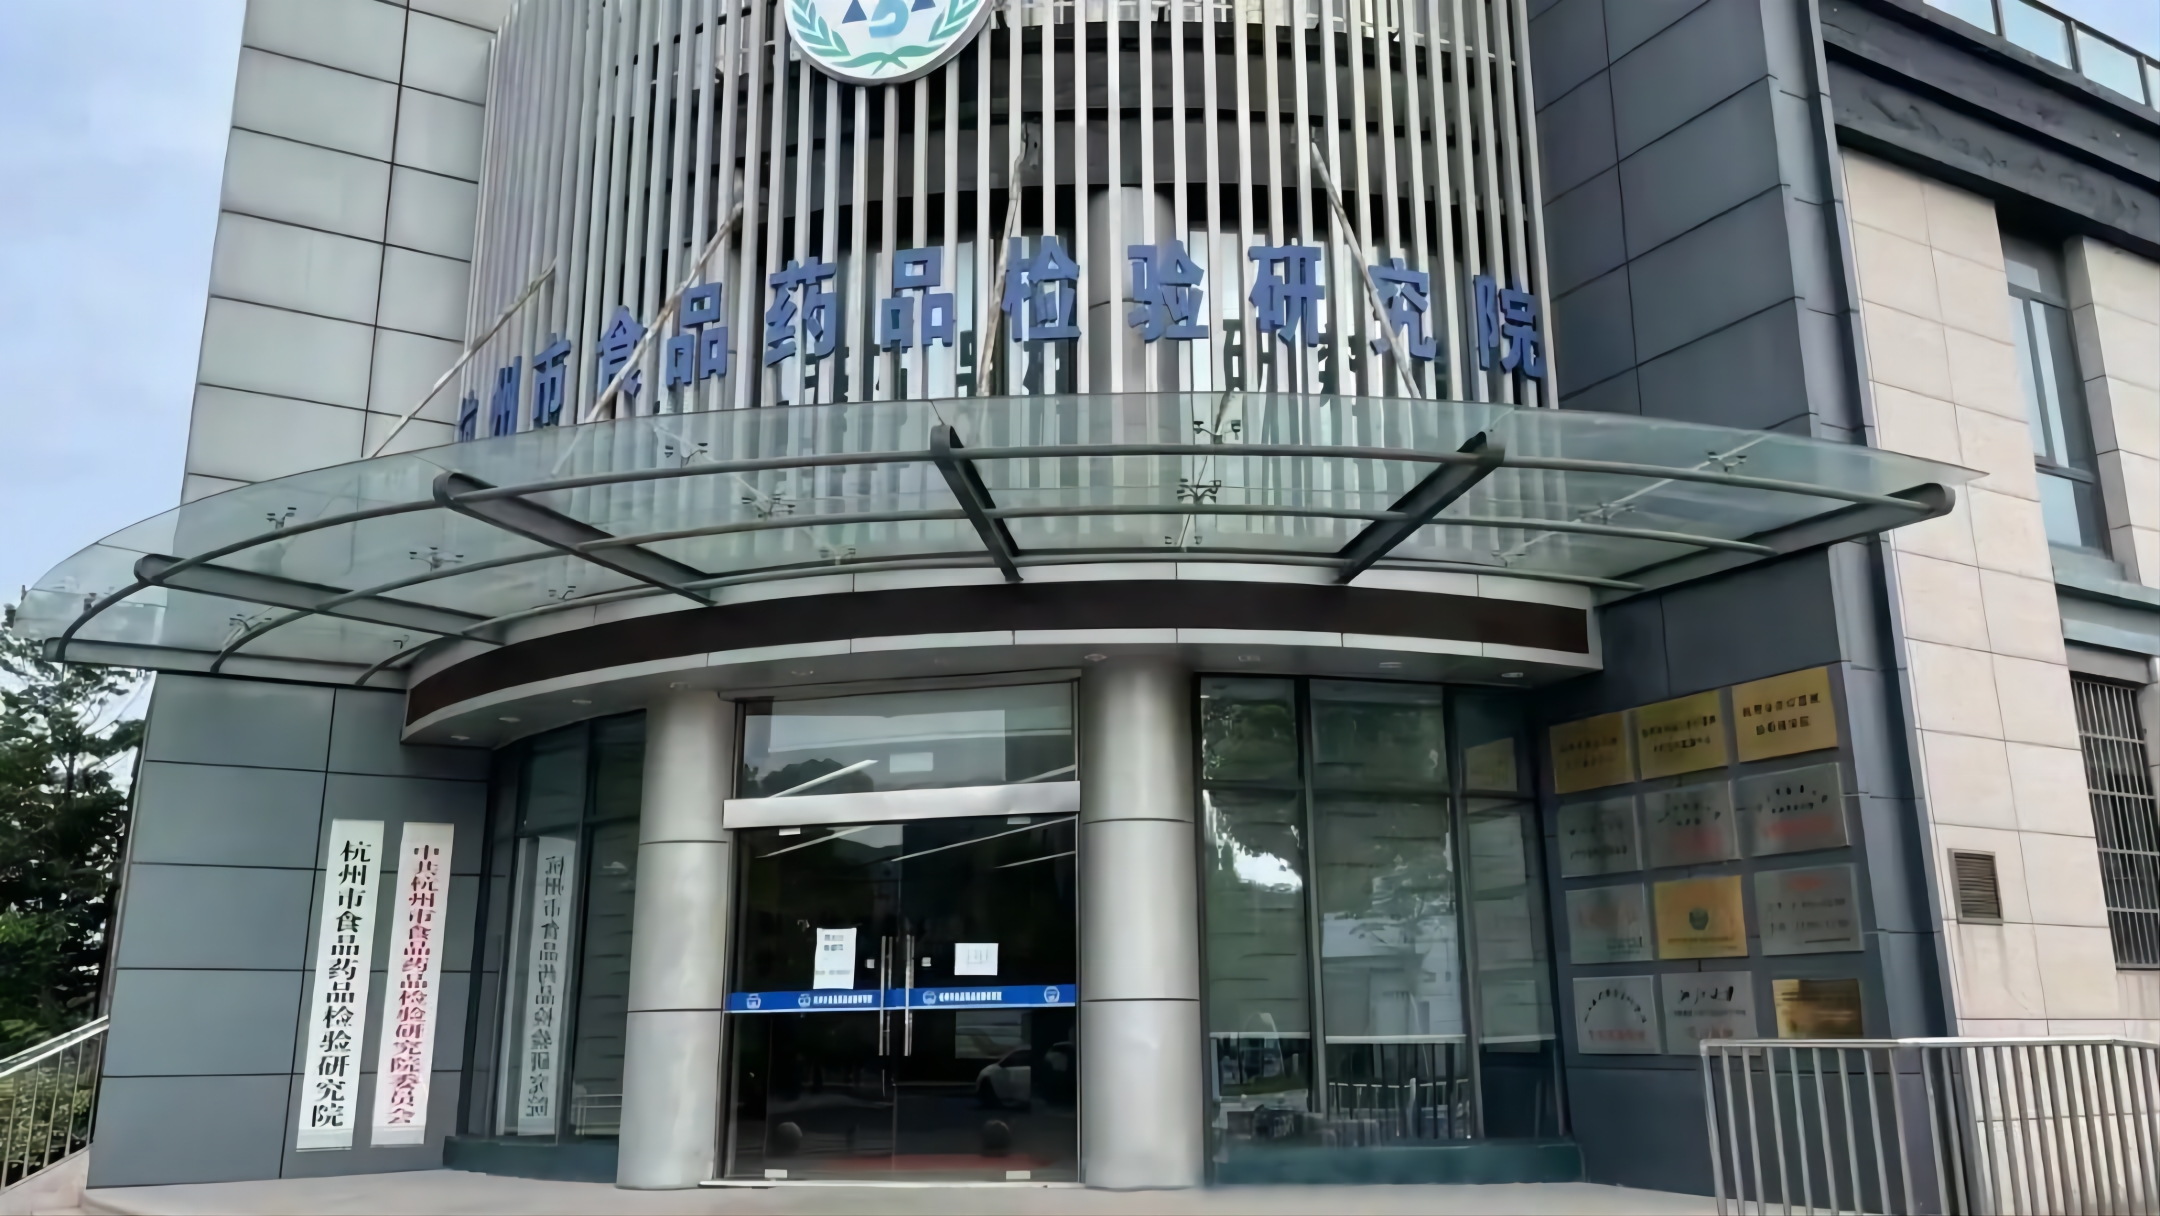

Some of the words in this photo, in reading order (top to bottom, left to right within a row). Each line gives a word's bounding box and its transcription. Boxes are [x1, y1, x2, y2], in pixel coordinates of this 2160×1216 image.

[311, 840, 371, 1128] 杭州市食品药品检验研究院
[388, 844, 440, 1124] 中共杭州市食品药品检验研究院委员会
